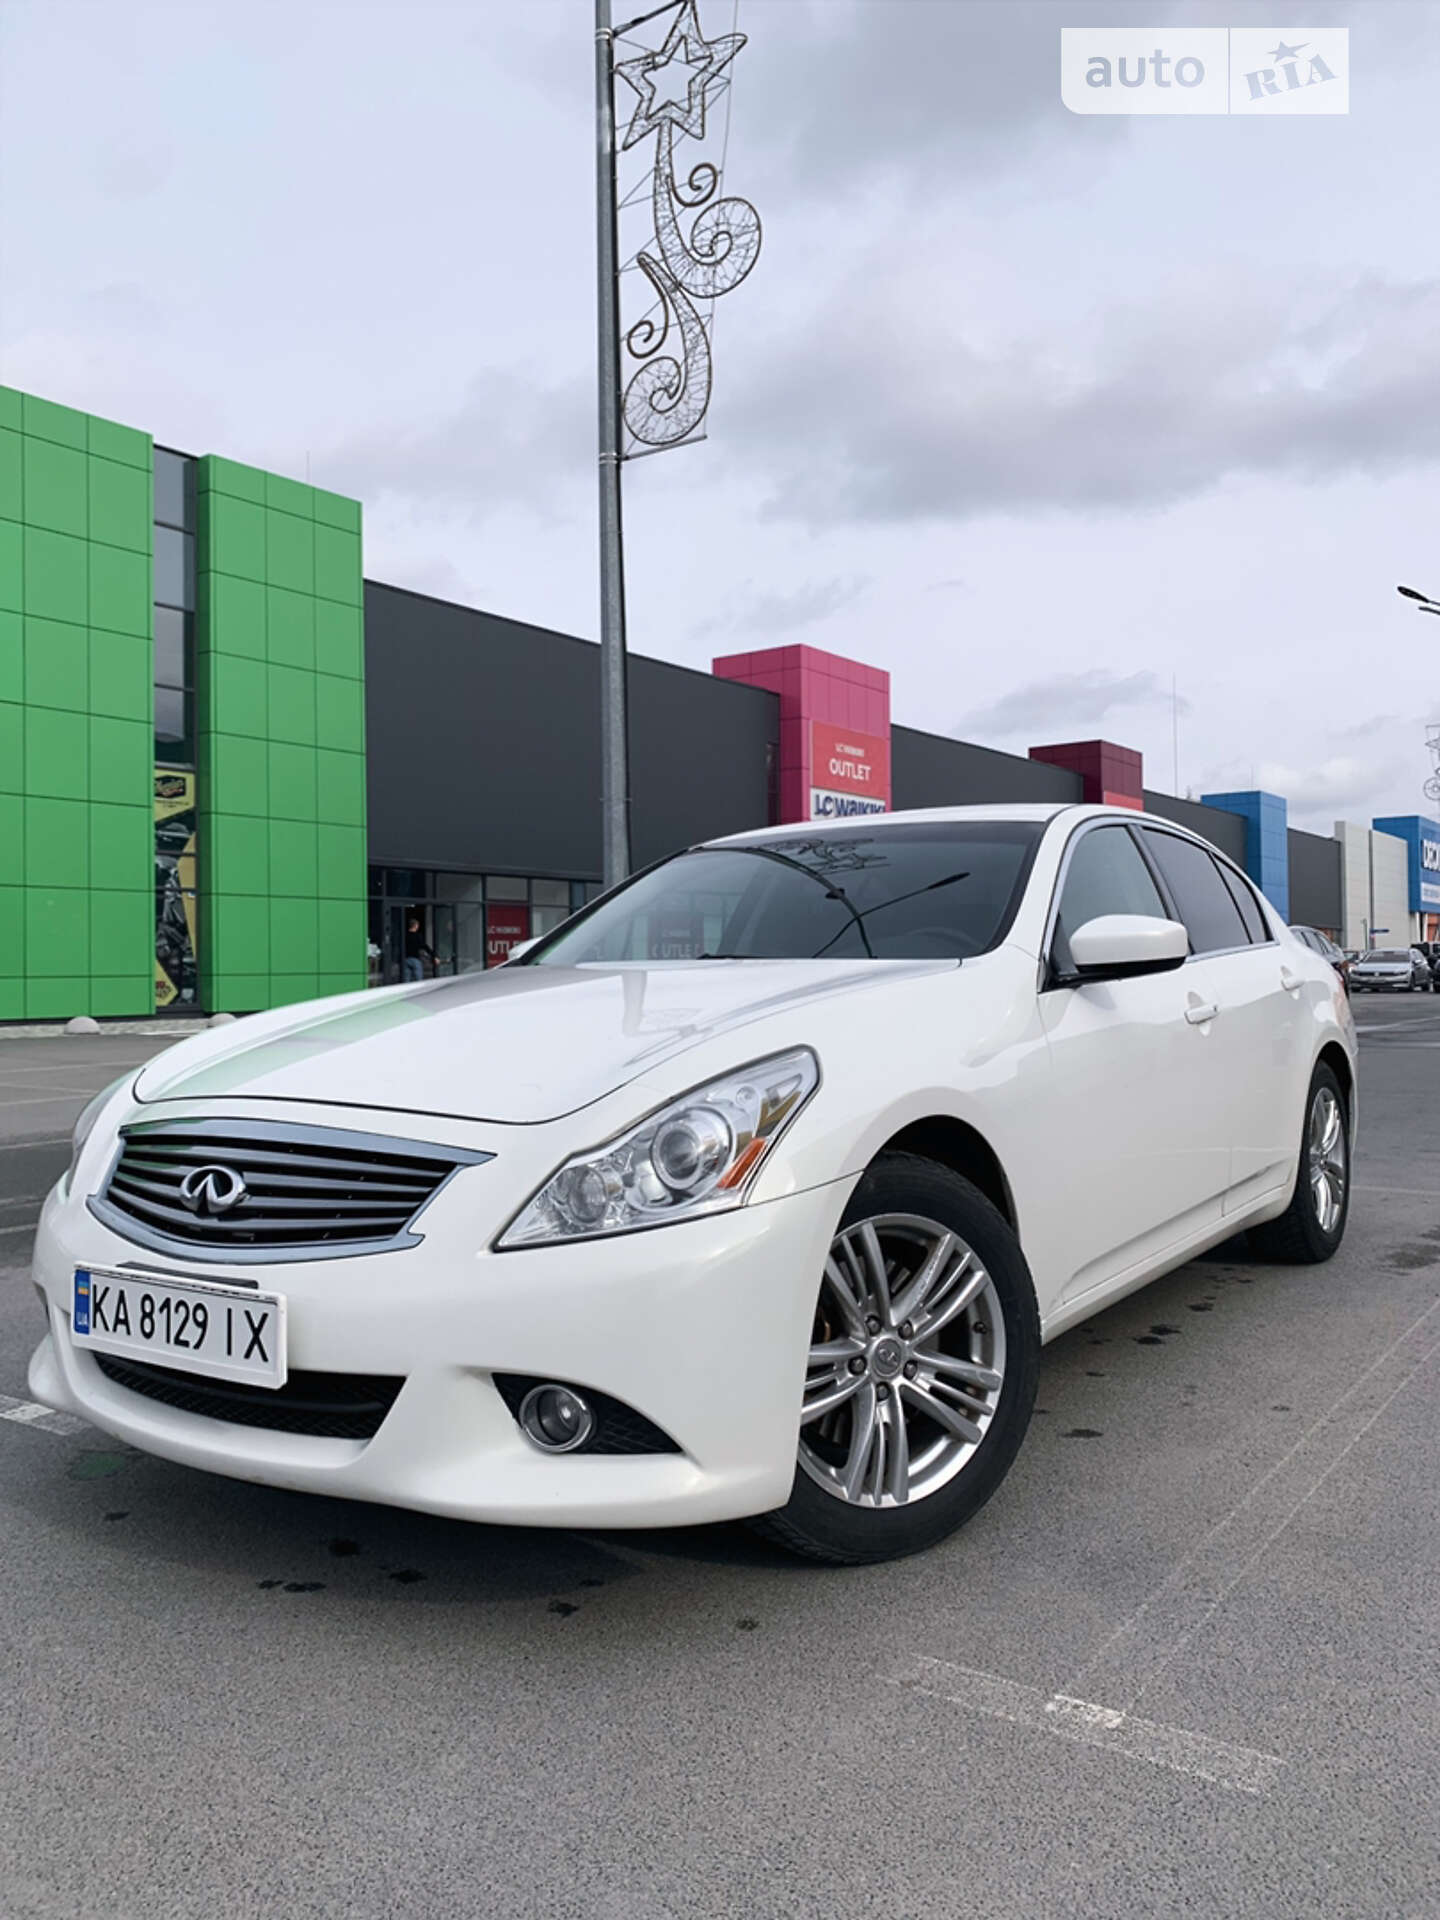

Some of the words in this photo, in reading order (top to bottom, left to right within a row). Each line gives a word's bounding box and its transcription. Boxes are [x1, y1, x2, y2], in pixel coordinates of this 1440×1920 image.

[829, 758, 871, 781] OUTLET
[814, 794, 833, 816] LC
[92, 1284, 131, 1336] KA
[140, 1293, 208, 1350] 8129
[226, 1308, 269, 1363] IX
